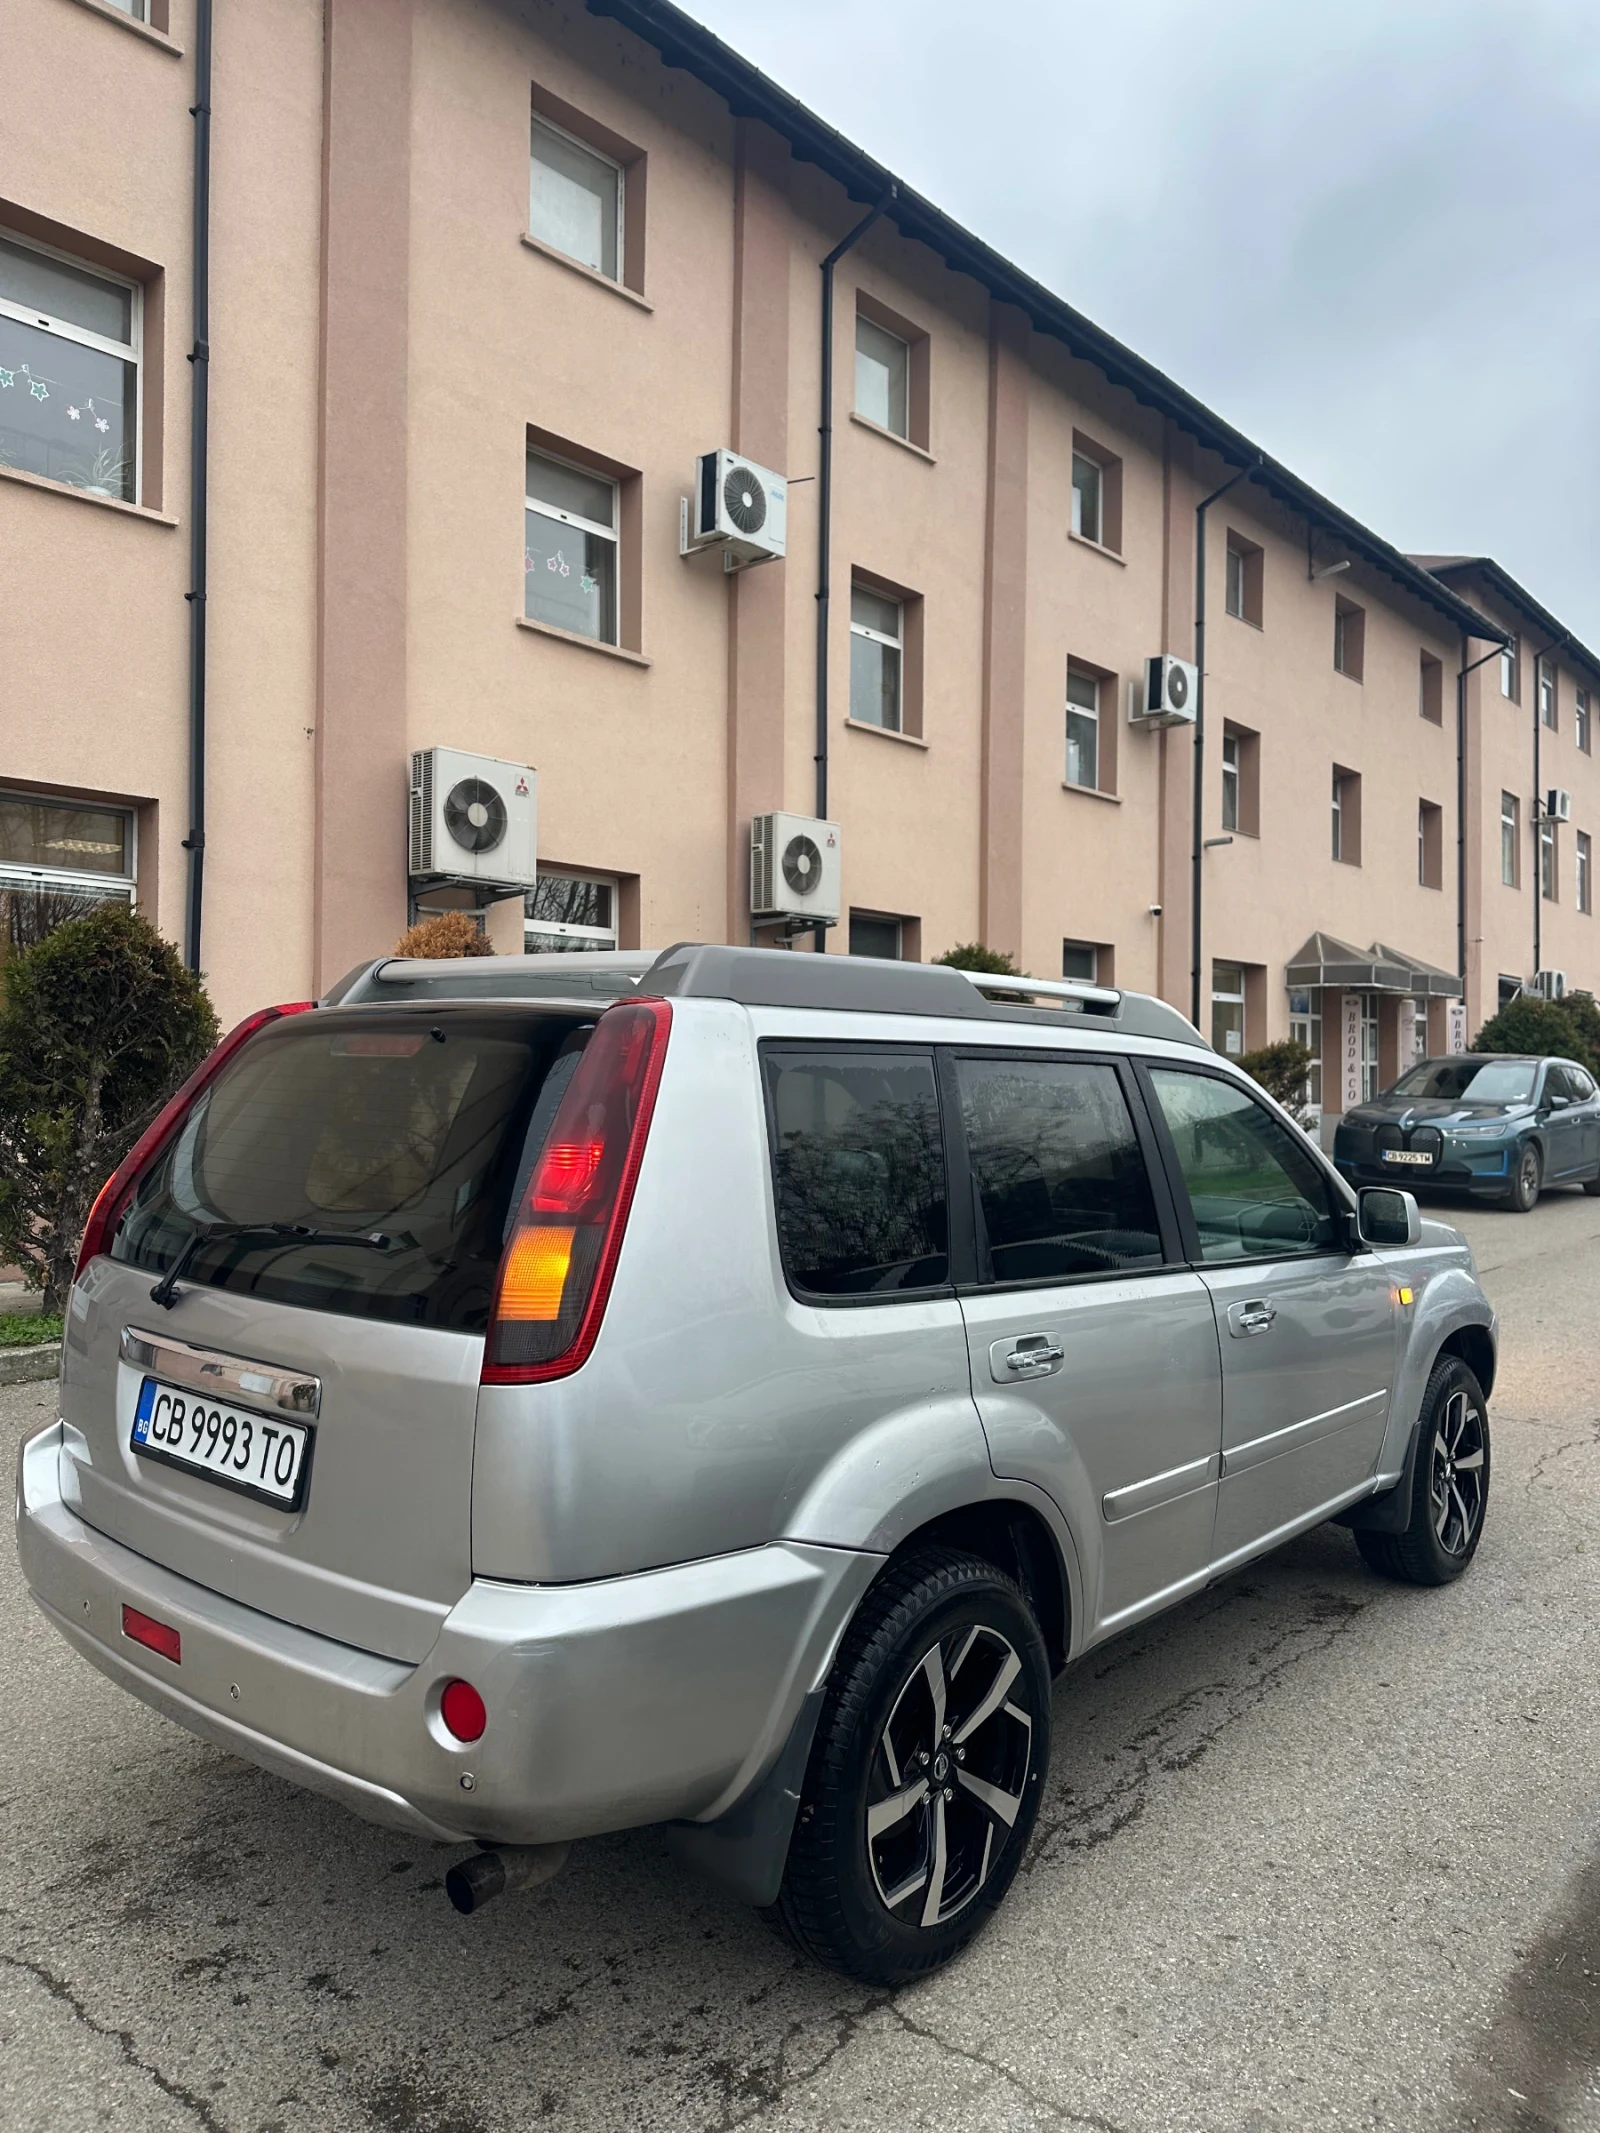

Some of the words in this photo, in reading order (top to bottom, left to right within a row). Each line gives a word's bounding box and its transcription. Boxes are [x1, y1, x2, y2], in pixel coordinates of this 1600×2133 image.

[1348, 1011, 1356, 1058] BROD
[1347, 1063, 1356, 1073] &
[1348, 1078, 1356, 1100] CO
[1399, 1152, 1418, 1162] 9225
[137, 1418, 149, 1435] BG
[152, 1394, 186, 1446] CB
[189, 1405, 253, 1470] 9993
[261, 1426, 295, 1486] TO
